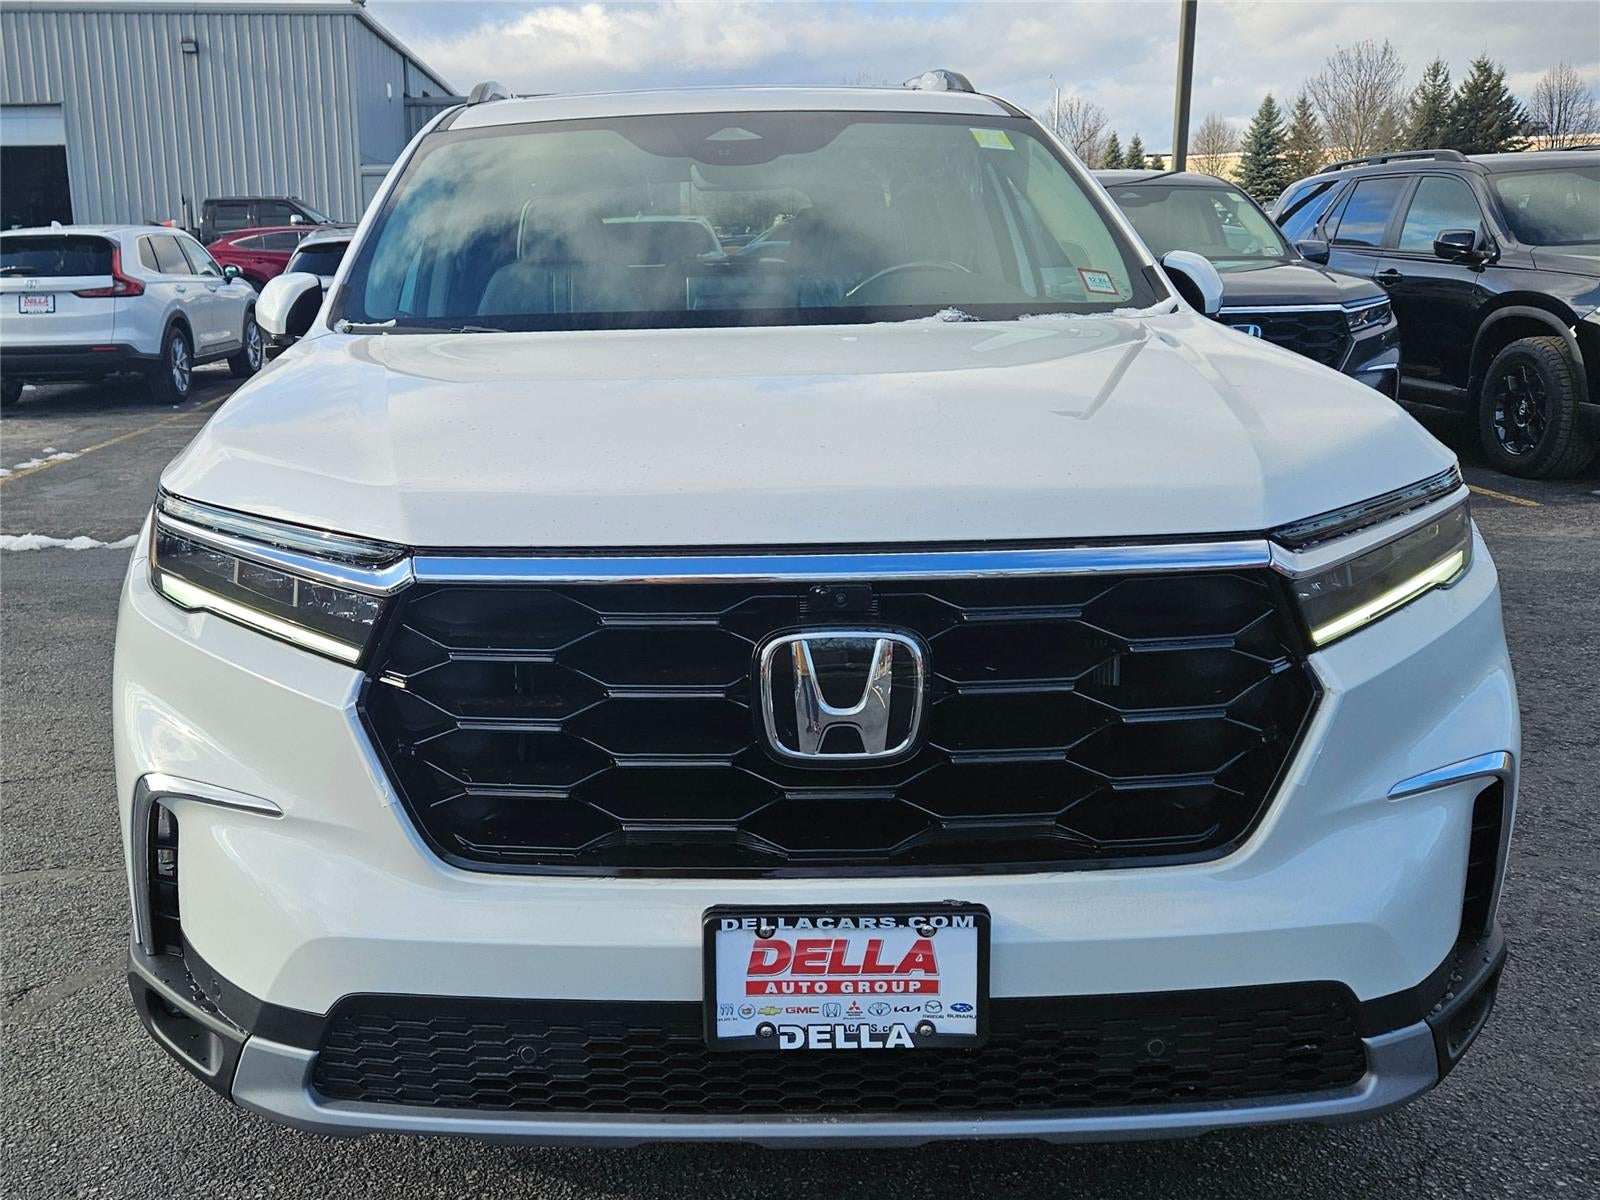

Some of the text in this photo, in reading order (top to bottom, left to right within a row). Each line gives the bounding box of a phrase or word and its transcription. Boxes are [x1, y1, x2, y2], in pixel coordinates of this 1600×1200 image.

[721, 916, 974, 931] DELLACARS.COM
[746, 938, 940, 977] DELLA
[765, 980, 922, 993] AUTO GROUP
[785, 1006, 820, 1015] GMC
[779, 1025, 915, 1050] DELLA
